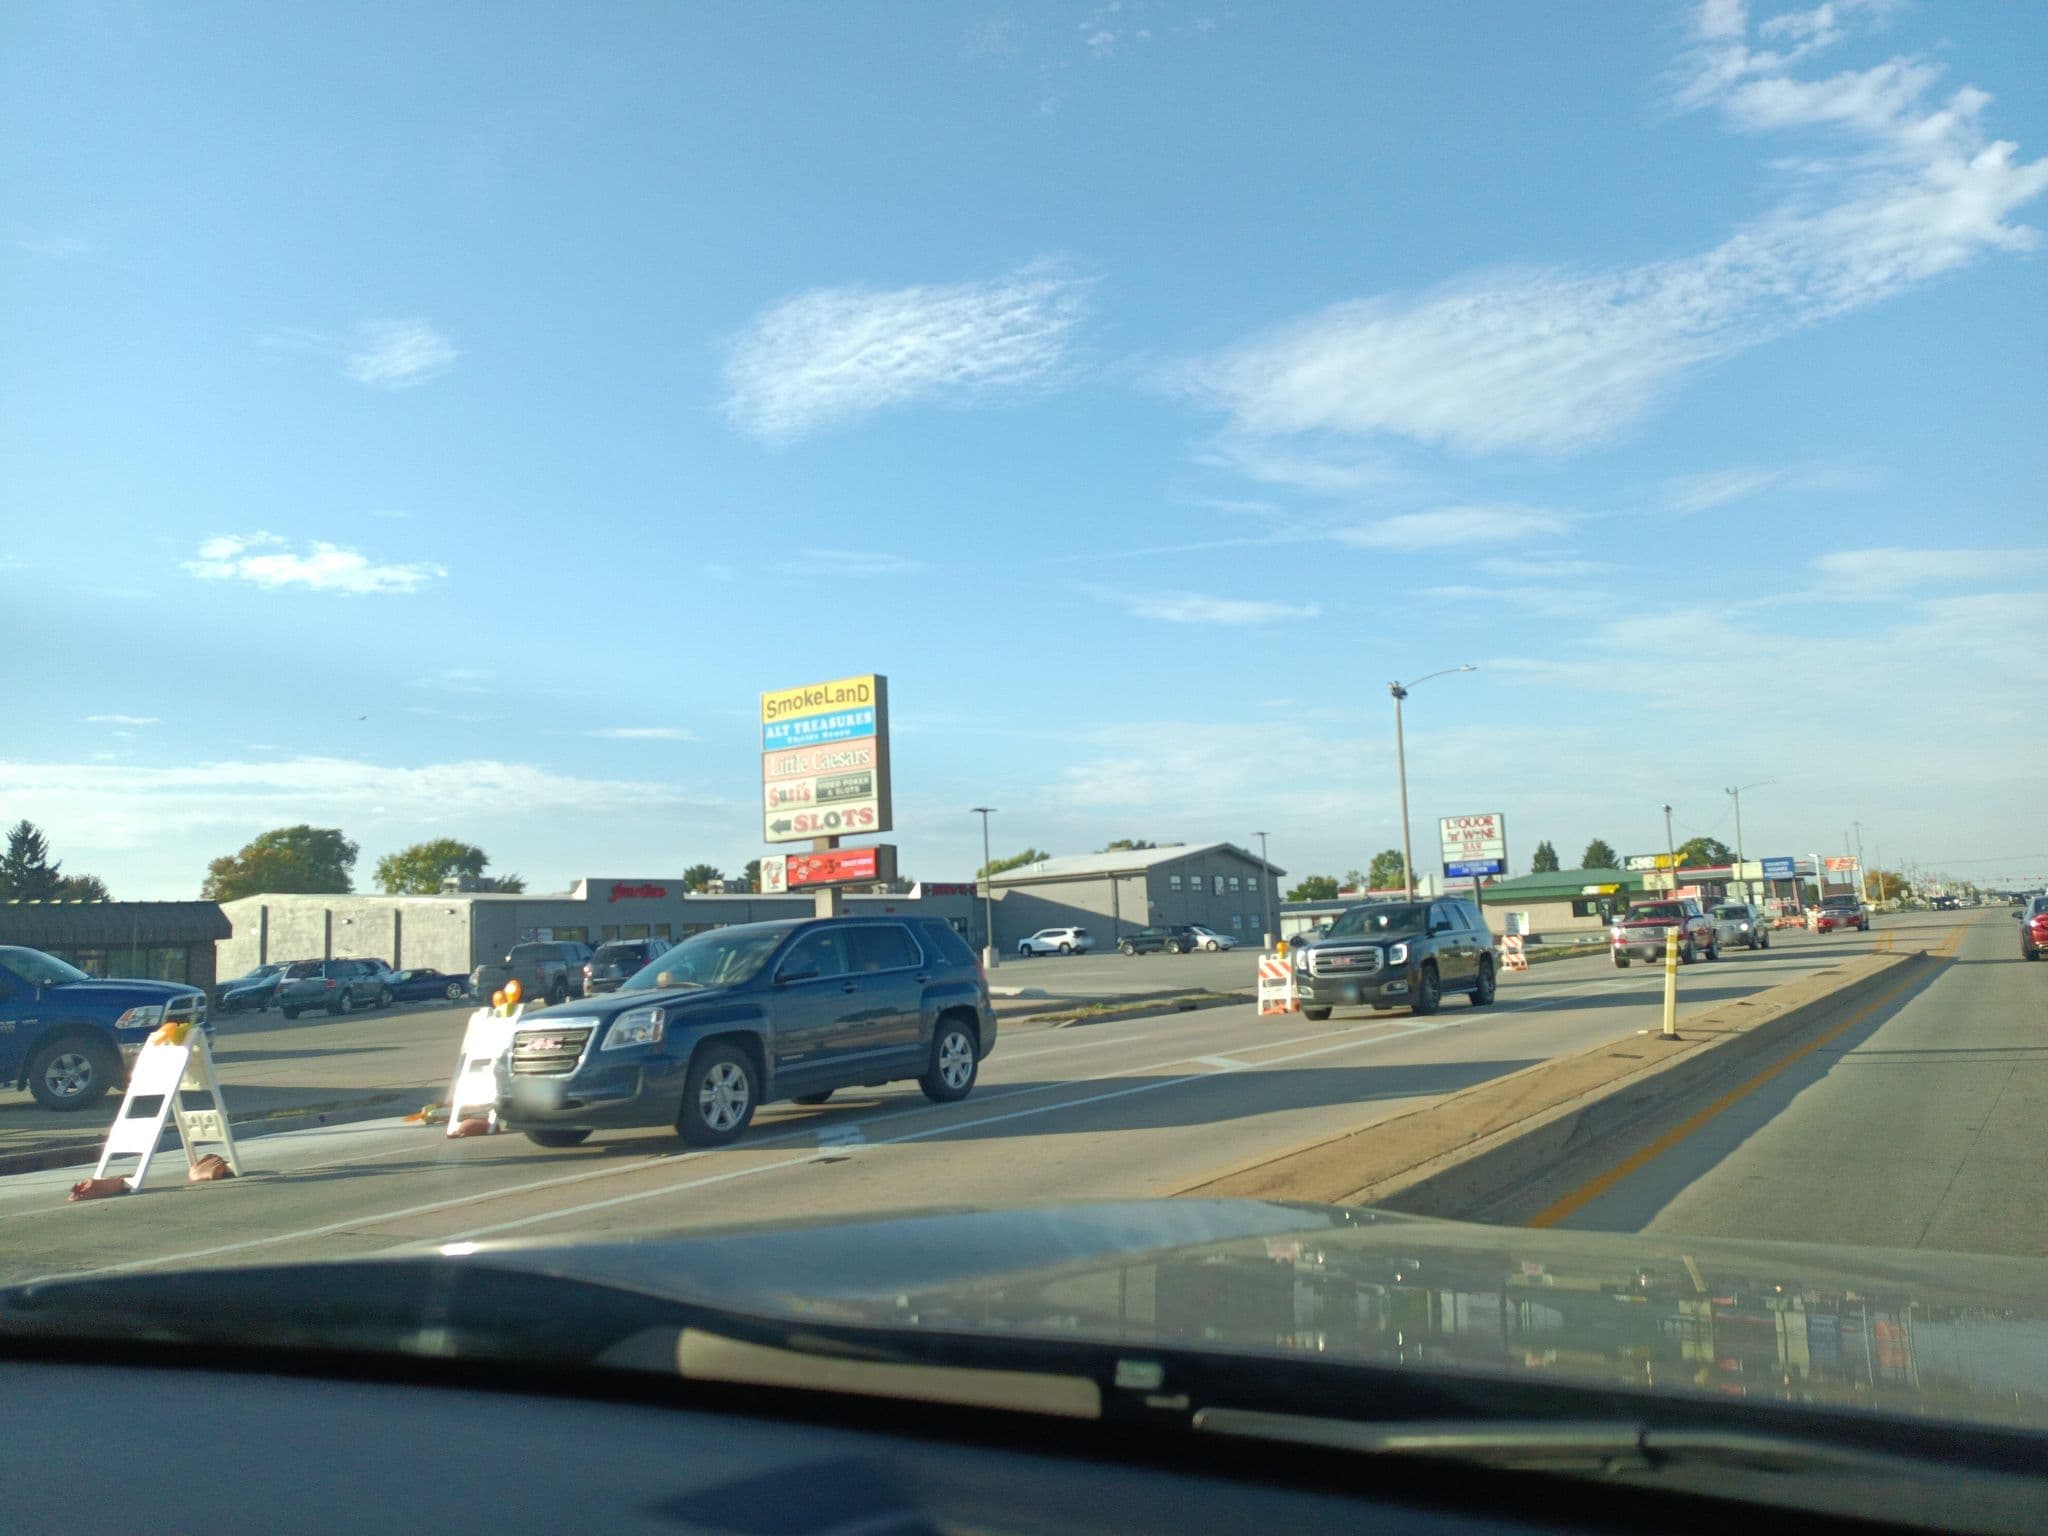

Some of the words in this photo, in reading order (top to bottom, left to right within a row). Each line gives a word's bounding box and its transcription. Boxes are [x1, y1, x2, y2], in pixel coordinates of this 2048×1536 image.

[766, 683, 870, 718] SmokeLanD
[766, 724, 790, 738] ALT
[794, 711, 872, 733] TREASURES
[812, 749, 870, 771] Caesars
[793, 807, 874, 833] SLOTS
